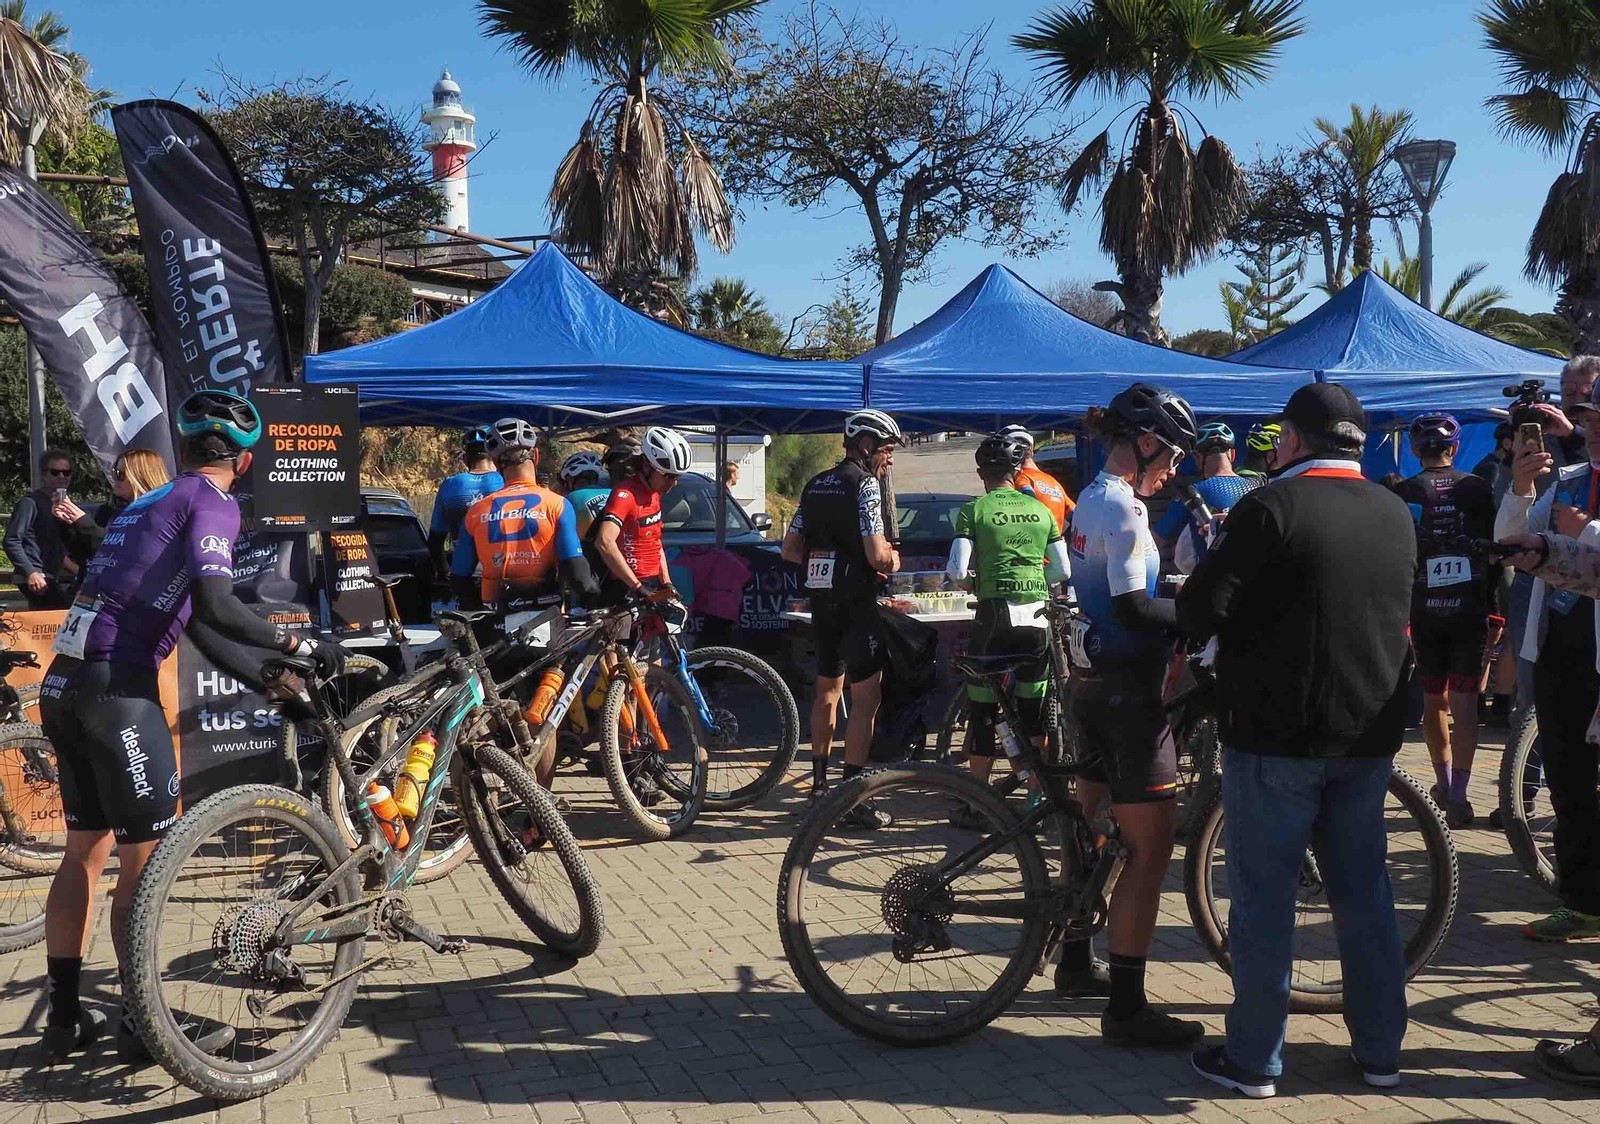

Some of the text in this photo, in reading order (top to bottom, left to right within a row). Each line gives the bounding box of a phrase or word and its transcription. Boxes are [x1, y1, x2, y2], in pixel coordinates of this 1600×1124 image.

[57, 291, 163, 446] BH
[268, 424, 343, 437] RECOGIDA
[275, 439, 337, 451] DE ROPA
[275, 458, 338, 469] CLOTHING
[268, 471, 346, 482] COLLECTION
[508, 508, 547, 520] Bikes
[331, 534, 368, 547] RECOGIDA
[336, 548, 368, 561] DE ROPA
[338, 565, 370, 579] CLOTHING
[810, 563, 829, 577] 318
[1433, 561, 1463, 577] 411
[199, 708, 247, 732] tus
[119, 725, 153, 799] ideallpack
[254, 798, 308, 817] MAXXIS
